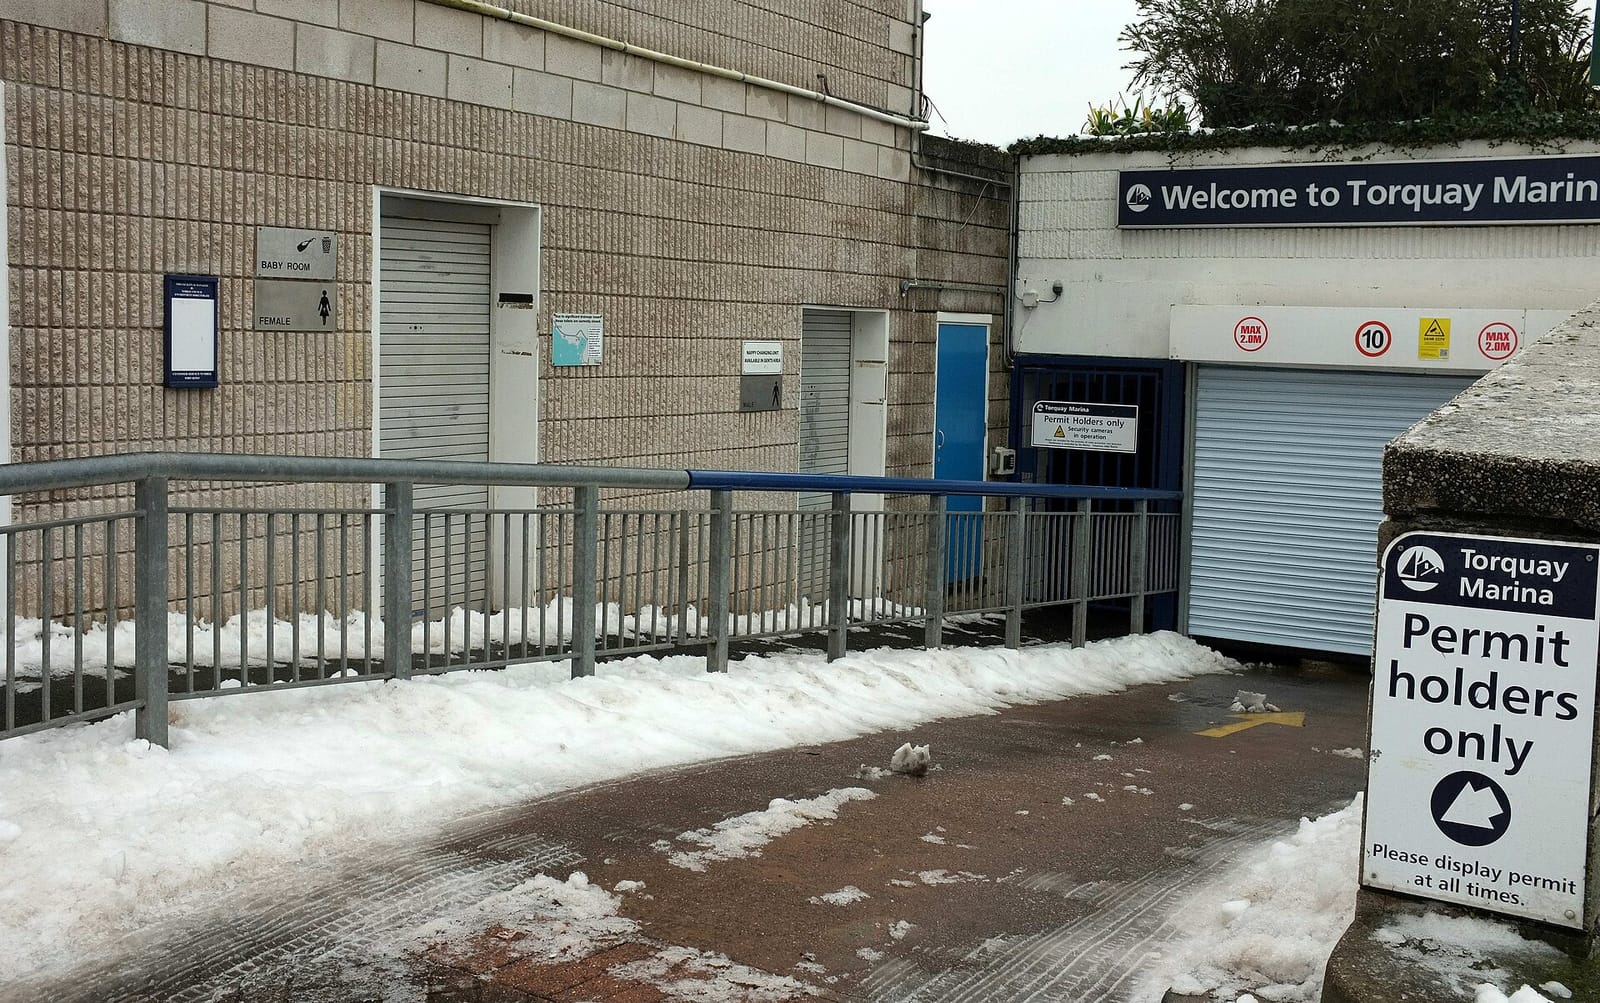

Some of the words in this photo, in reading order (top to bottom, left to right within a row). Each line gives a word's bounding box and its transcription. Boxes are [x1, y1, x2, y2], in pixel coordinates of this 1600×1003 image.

[1161, 182, 1297, 210] Welcome
[1305, 183, 1341, 207] to
[1346, 180, 1484, 212] Torquay
[261, 261, 283, 270] BABY
[287, 262, 311, 271] ROOM
[259, 316, 291, 326] FEMALE
[1240, 325, 1262, 334] MAX
[1240, 334, 1262, 344] 2.0M
[1362, 329, 1384, 349] 10
[1485, 332, 1510, 341] MAX
[1485, 342, 1510, 351] 2.0M
[1045, 404, 1067, 412] Torquay
[1044, 415, 1070, 424] Permit
[1072, 417, 1104, 426] Holders
[1106, 419, 1125, 429] only
[1067, 426, 1090, 434] Security
[1460, 548, 1570, 583] Torquay
[1459, 576, 1554, 605] Marina
[1403, 612, 1570, 667] Permit
[1388, 659, 1579, 721] holders
[1423, 723, 1534, 776] only
[1372, 843, 1429, 866] Please
[1435, 855, 1502, 883] display
[1508, 870, 1577, 895] permit
[1414, 873, 1433, 888] at
[1438, 877, 1460, 893] all
[1466, 882, 1525, 907] times.
